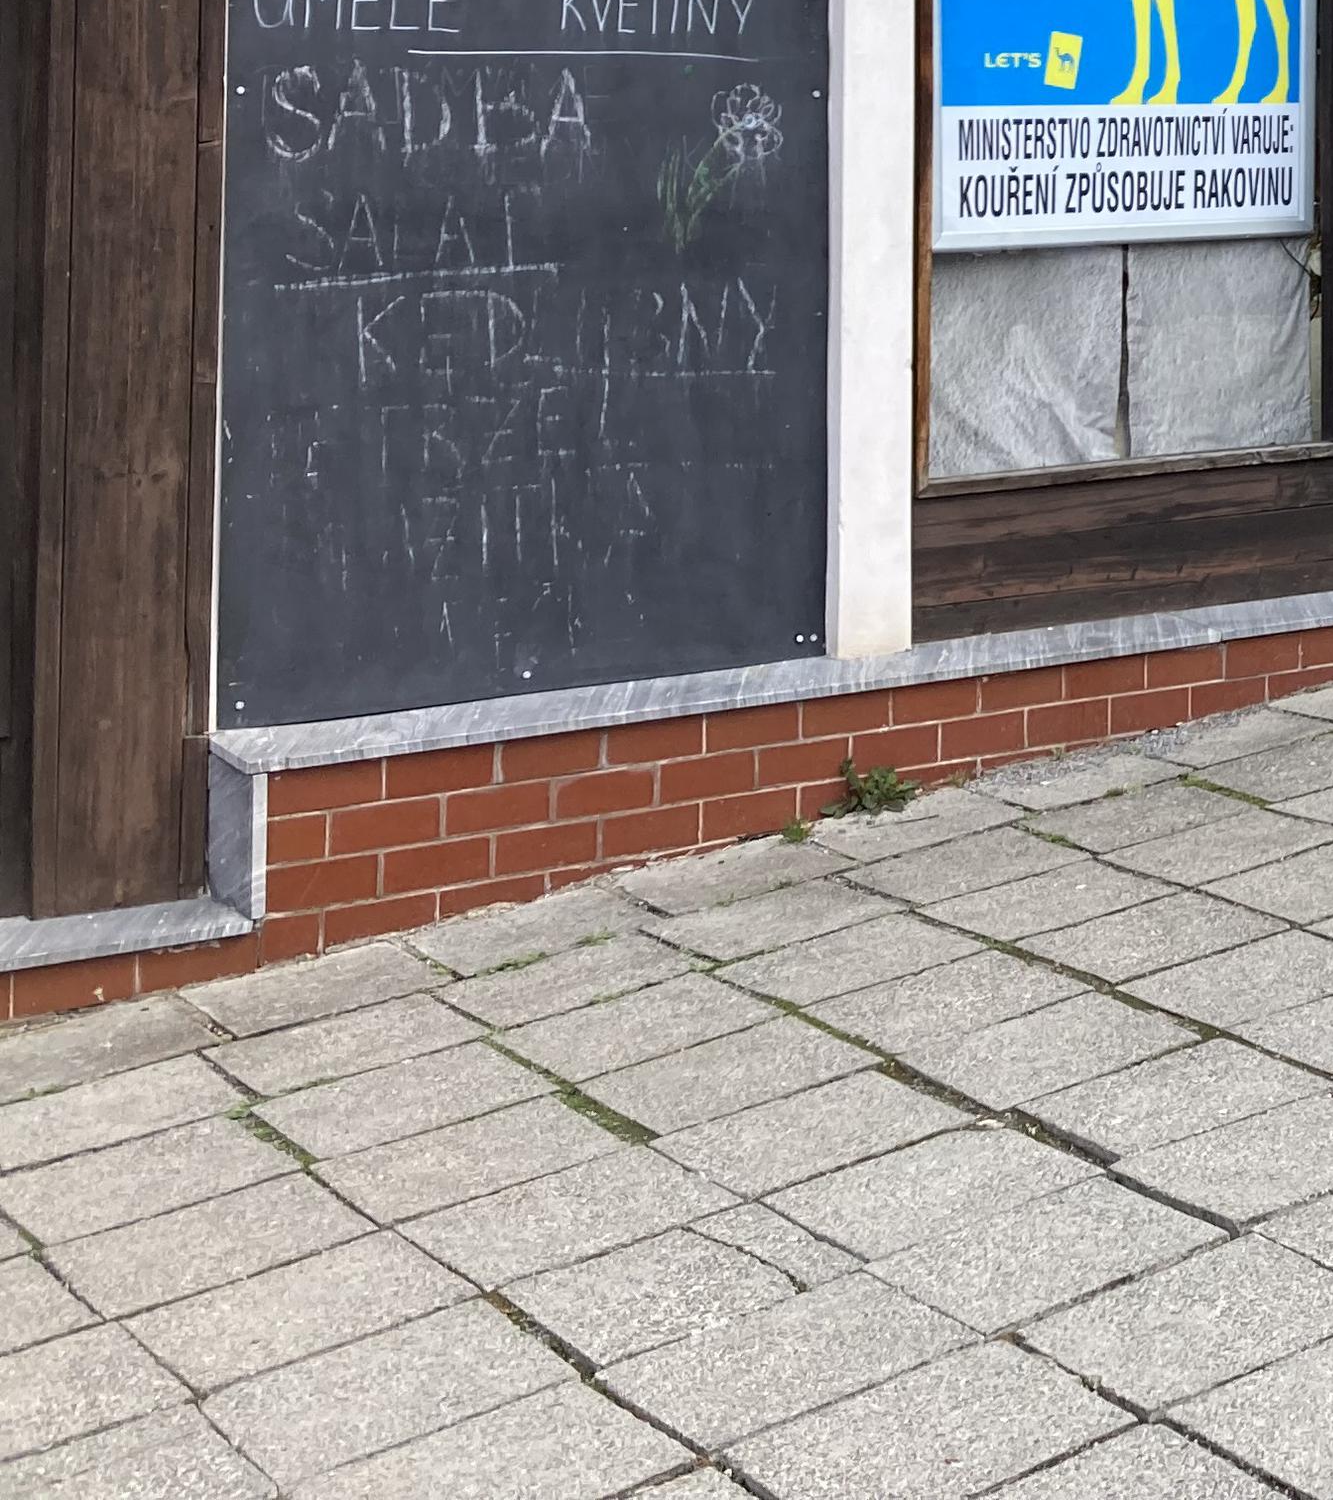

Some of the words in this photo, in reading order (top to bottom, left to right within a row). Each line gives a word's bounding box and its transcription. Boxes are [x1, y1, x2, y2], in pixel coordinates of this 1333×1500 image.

[984, 52, 1042, 69] LET'S
[958, 116, 1091, 162] MINISTERSTVO
[1096, 108, 1228, 159] ZDRAVOTNICTVÍ
[1231, 113, 1294, 154] VARUJE:
[959, 165, 1060, 218] KOUŘENÍ
[1065, 162, 1186, 214] ZPŮSOBUJE
[1193, 166, 1293, 211] RAKOVINU
